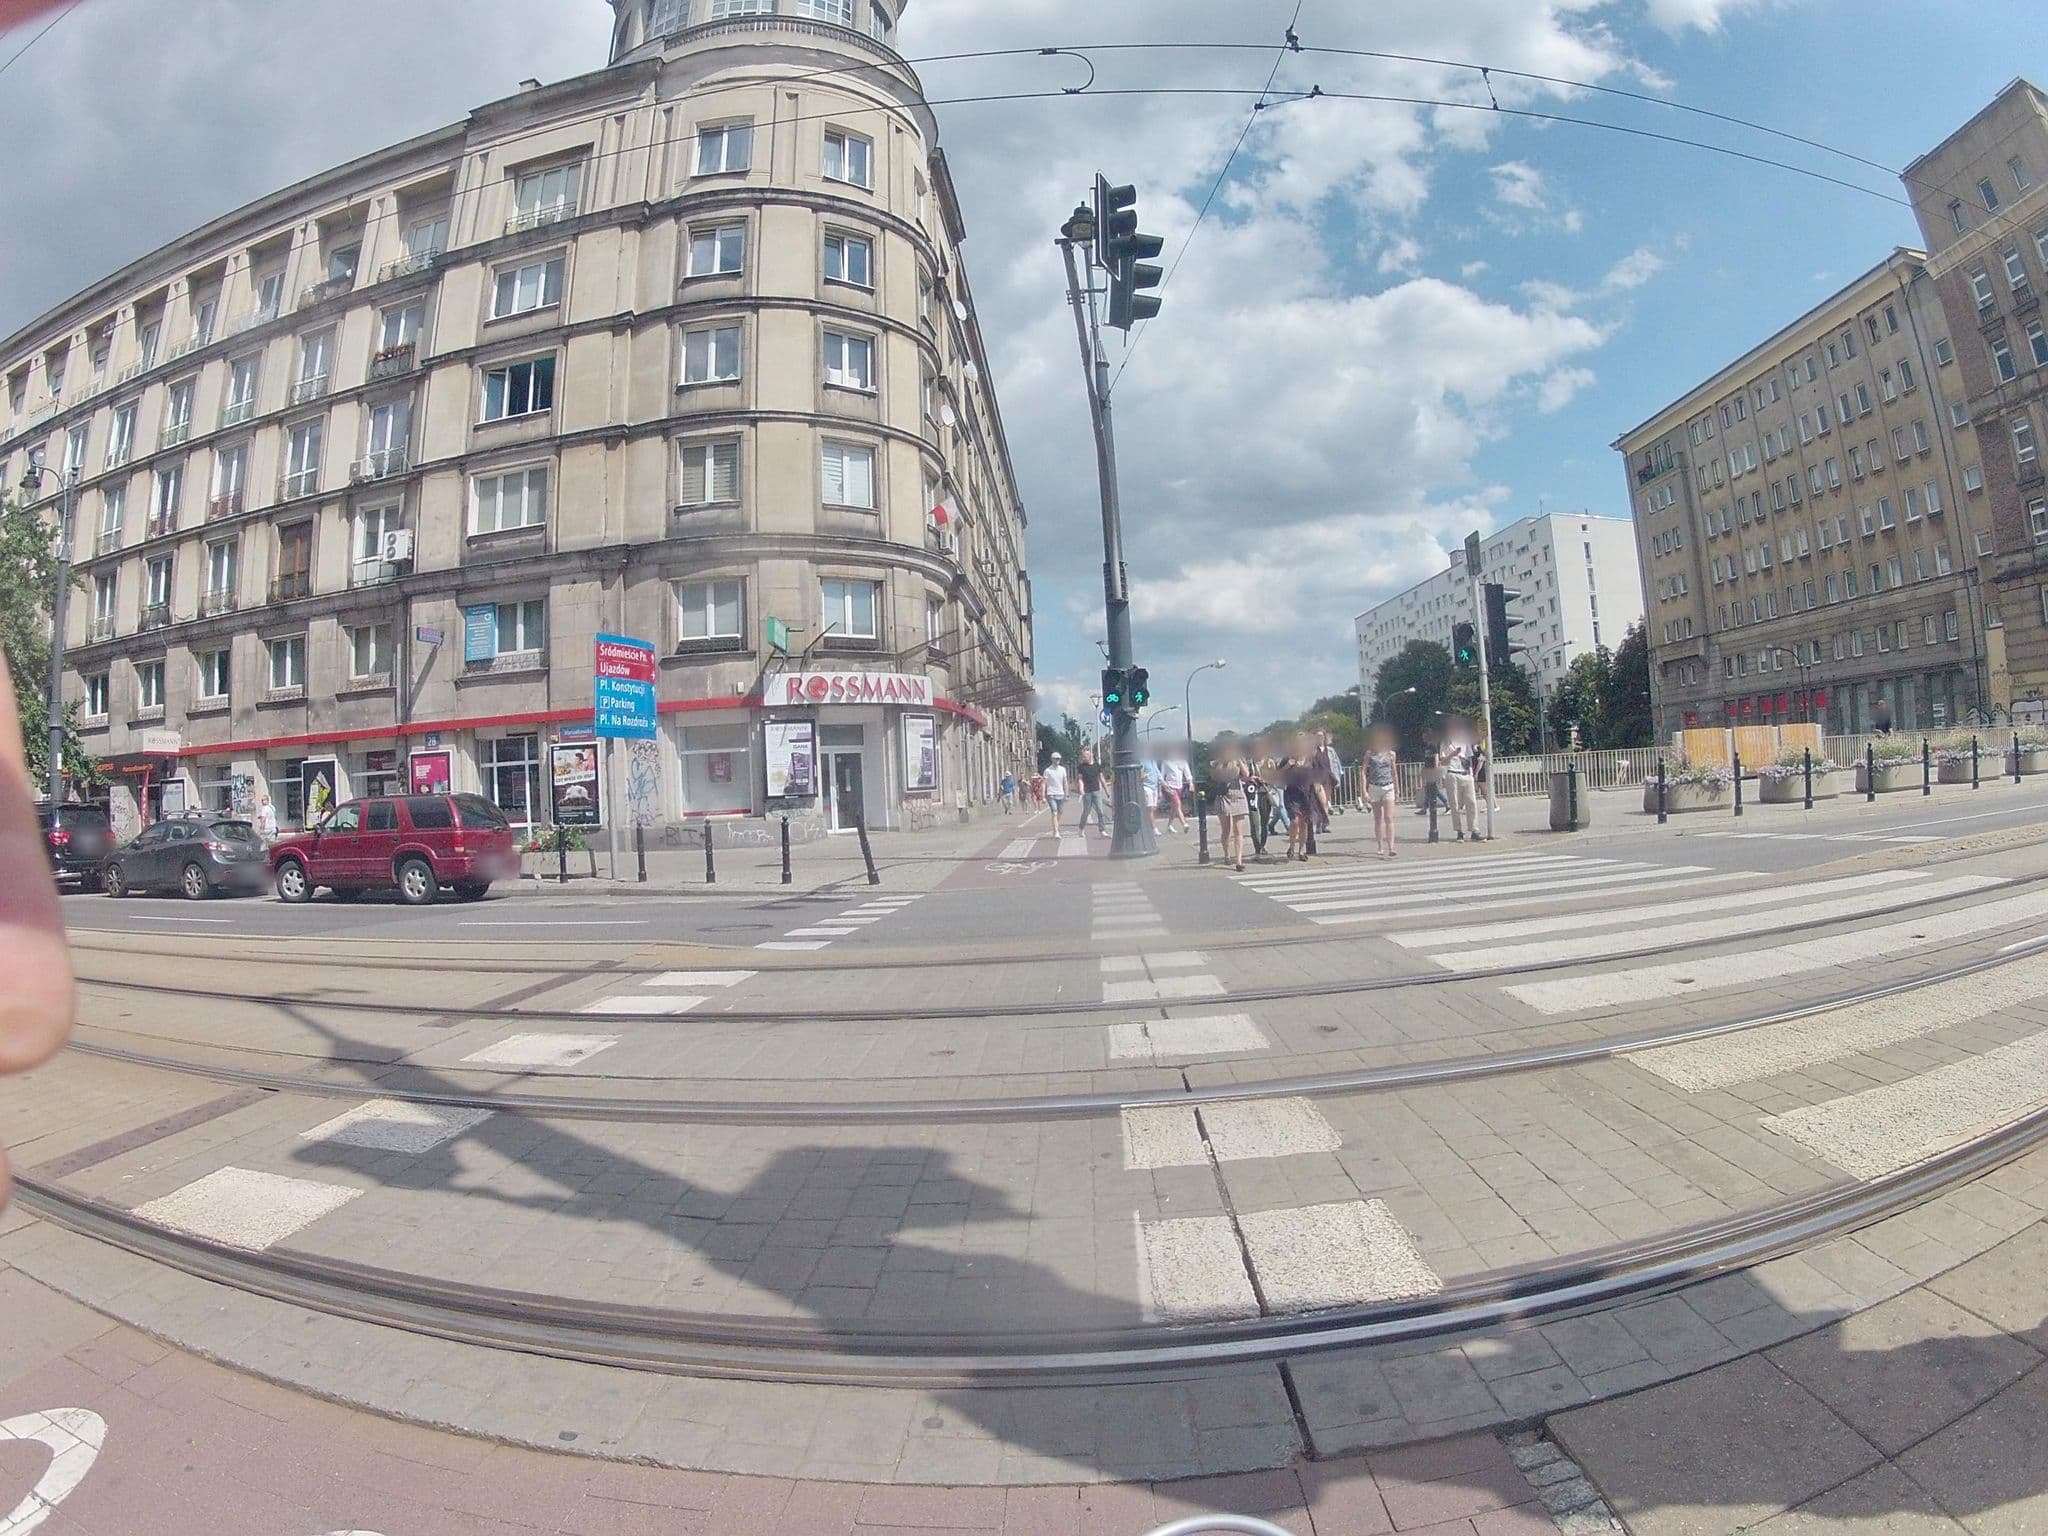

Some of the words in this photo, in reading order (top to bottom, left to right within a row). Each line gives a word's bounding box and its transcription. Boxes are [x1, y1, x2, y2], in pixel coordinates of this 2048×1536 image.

[600, 644, 639, 660] Śródmieście
[600, 661, 630, 676] Ujazdów
[600, 679, 611, 691] Pl.
[787, 676, 924, 702] ROSSMANN
[611, 697, 635, 712] Parking
[600, 714, 610, 725] Pl.
[611, 715, 621, 726] Na
